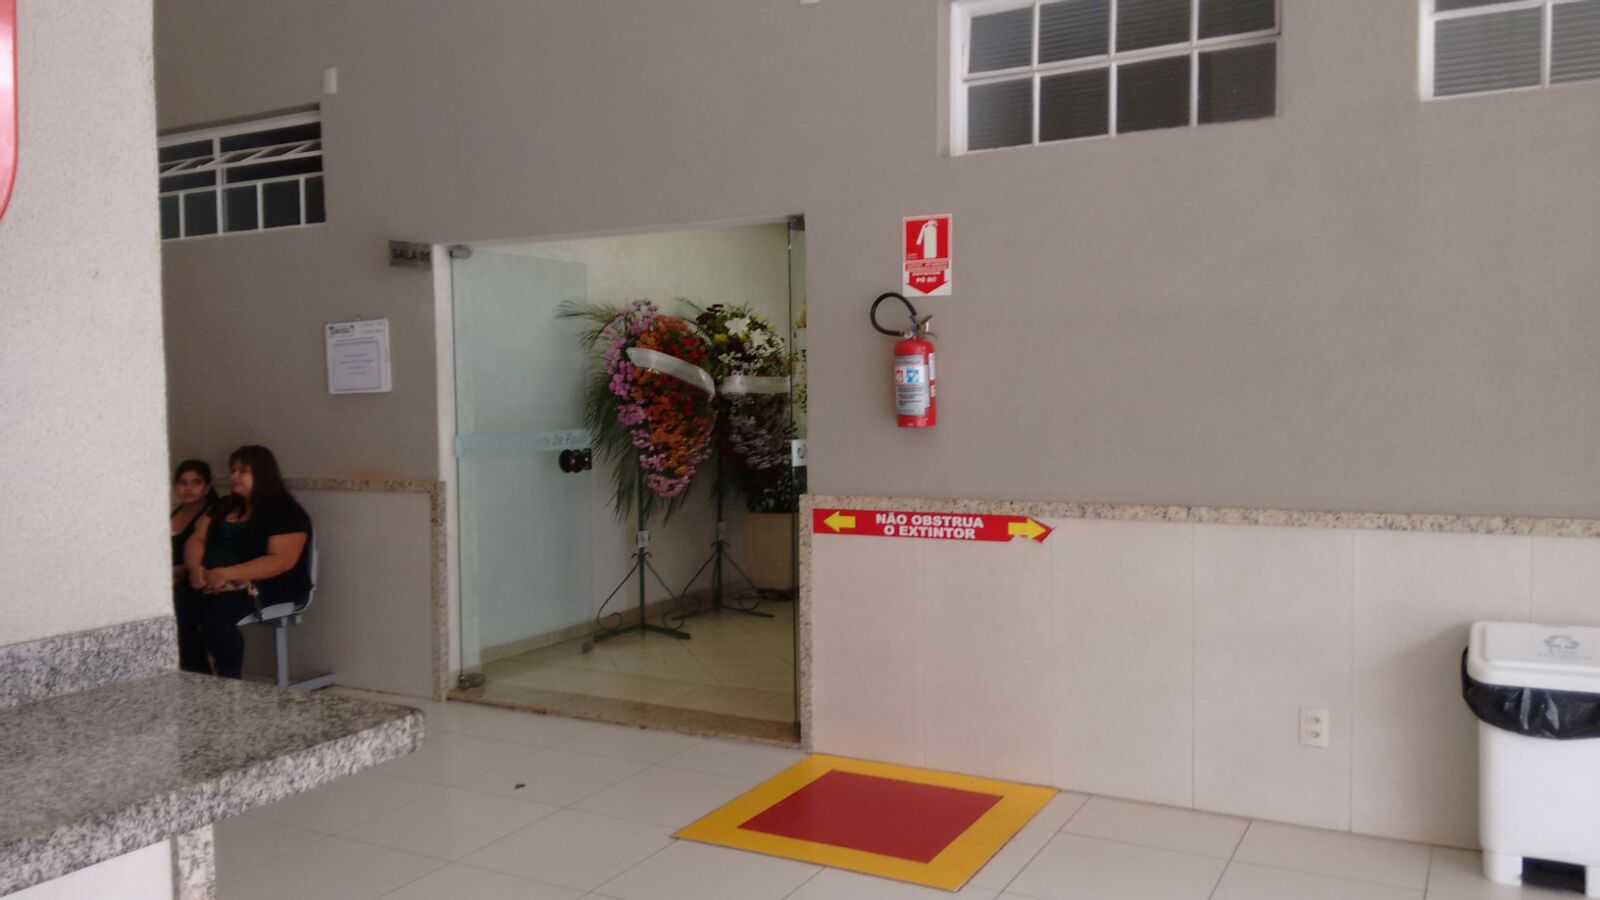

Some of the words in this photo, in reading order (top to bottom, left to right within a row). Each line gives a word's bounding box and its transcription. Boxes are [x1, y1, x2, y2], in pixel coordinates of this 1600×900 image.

[391, 247, 418, 261] SALA
[875, 511, 907, 525] NÃO
[911, 514, 984, 528] OBSTRUA
[883, 524, 895, 536] O
[899, 525, 976, 539] EXTINTOR
